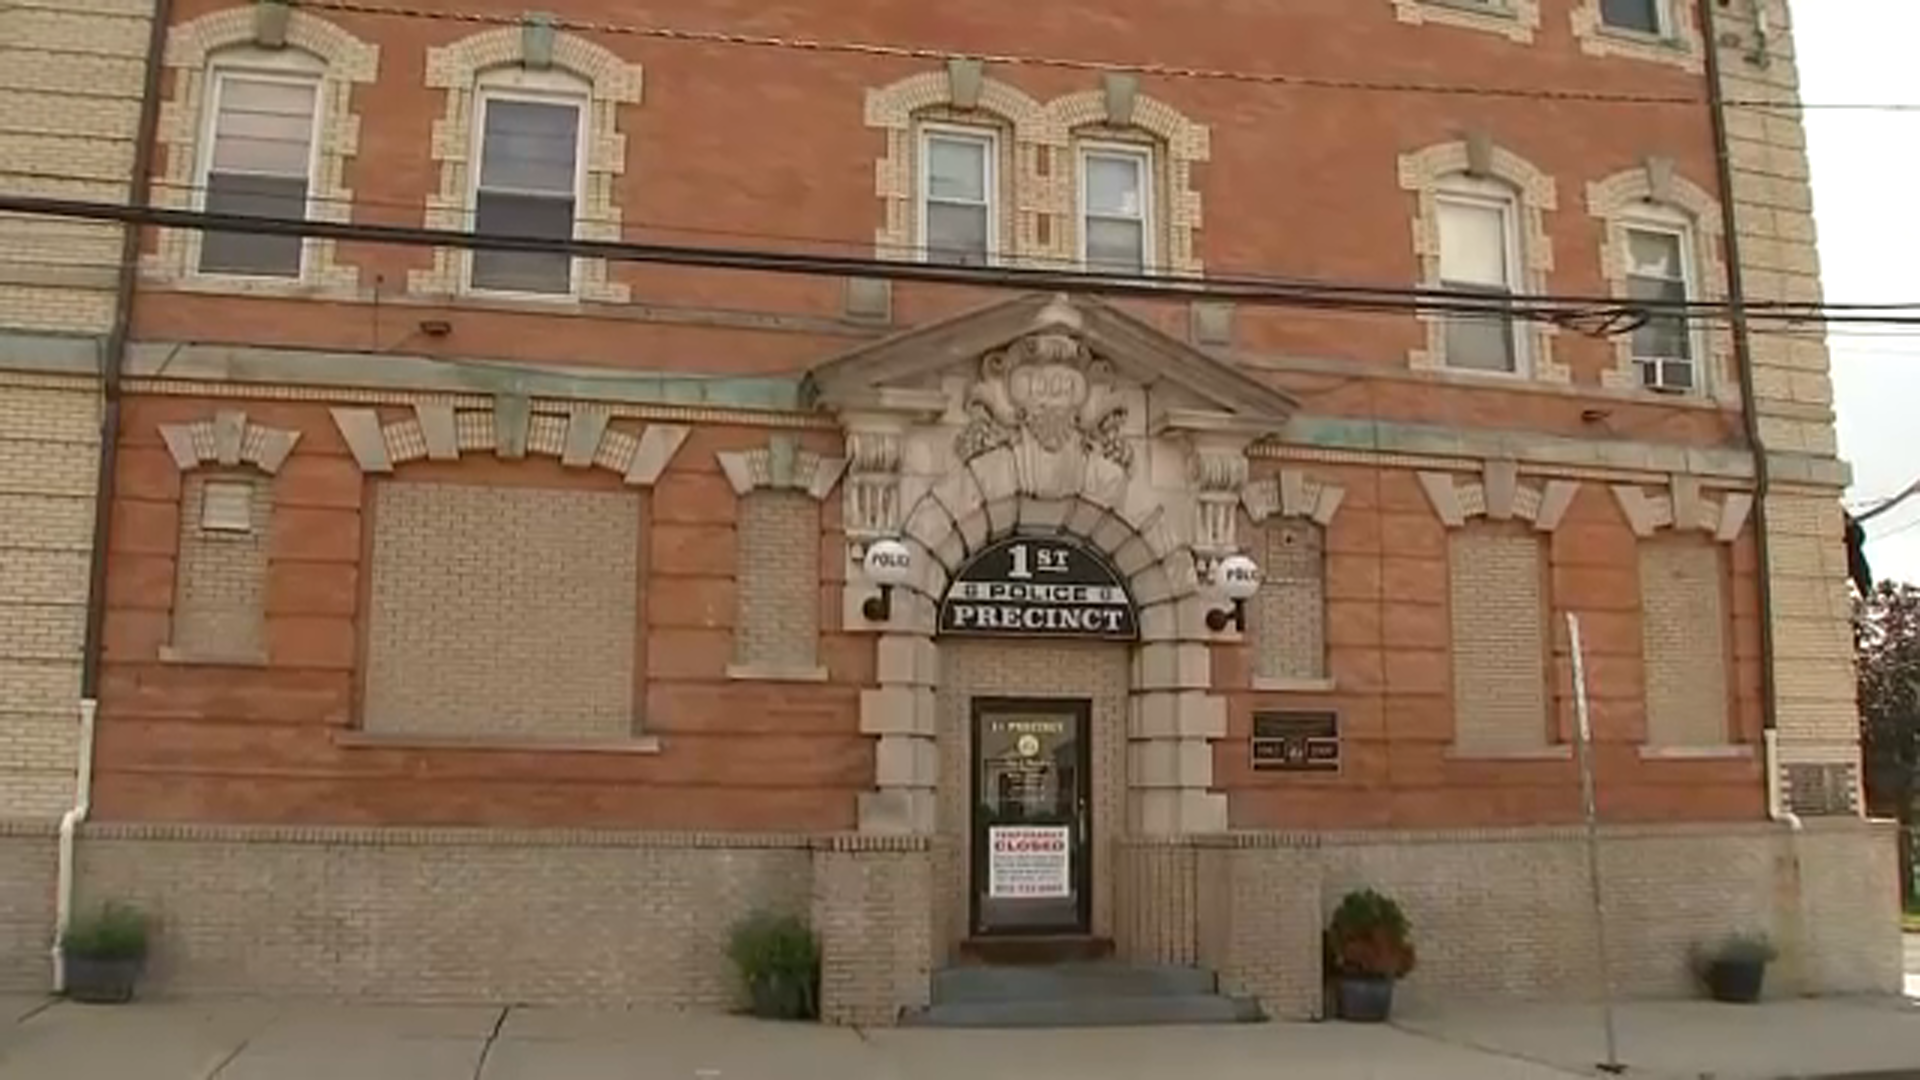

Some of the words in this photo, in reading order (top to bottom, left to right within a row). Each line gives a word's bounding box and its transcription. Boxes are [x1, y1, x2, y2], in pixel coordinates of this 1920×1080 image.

[989, 584, 1087, 601] POLICE
[953, 604, 1123, 631] PRECINCT
[994, 840, 1065, 852] CLOSED
